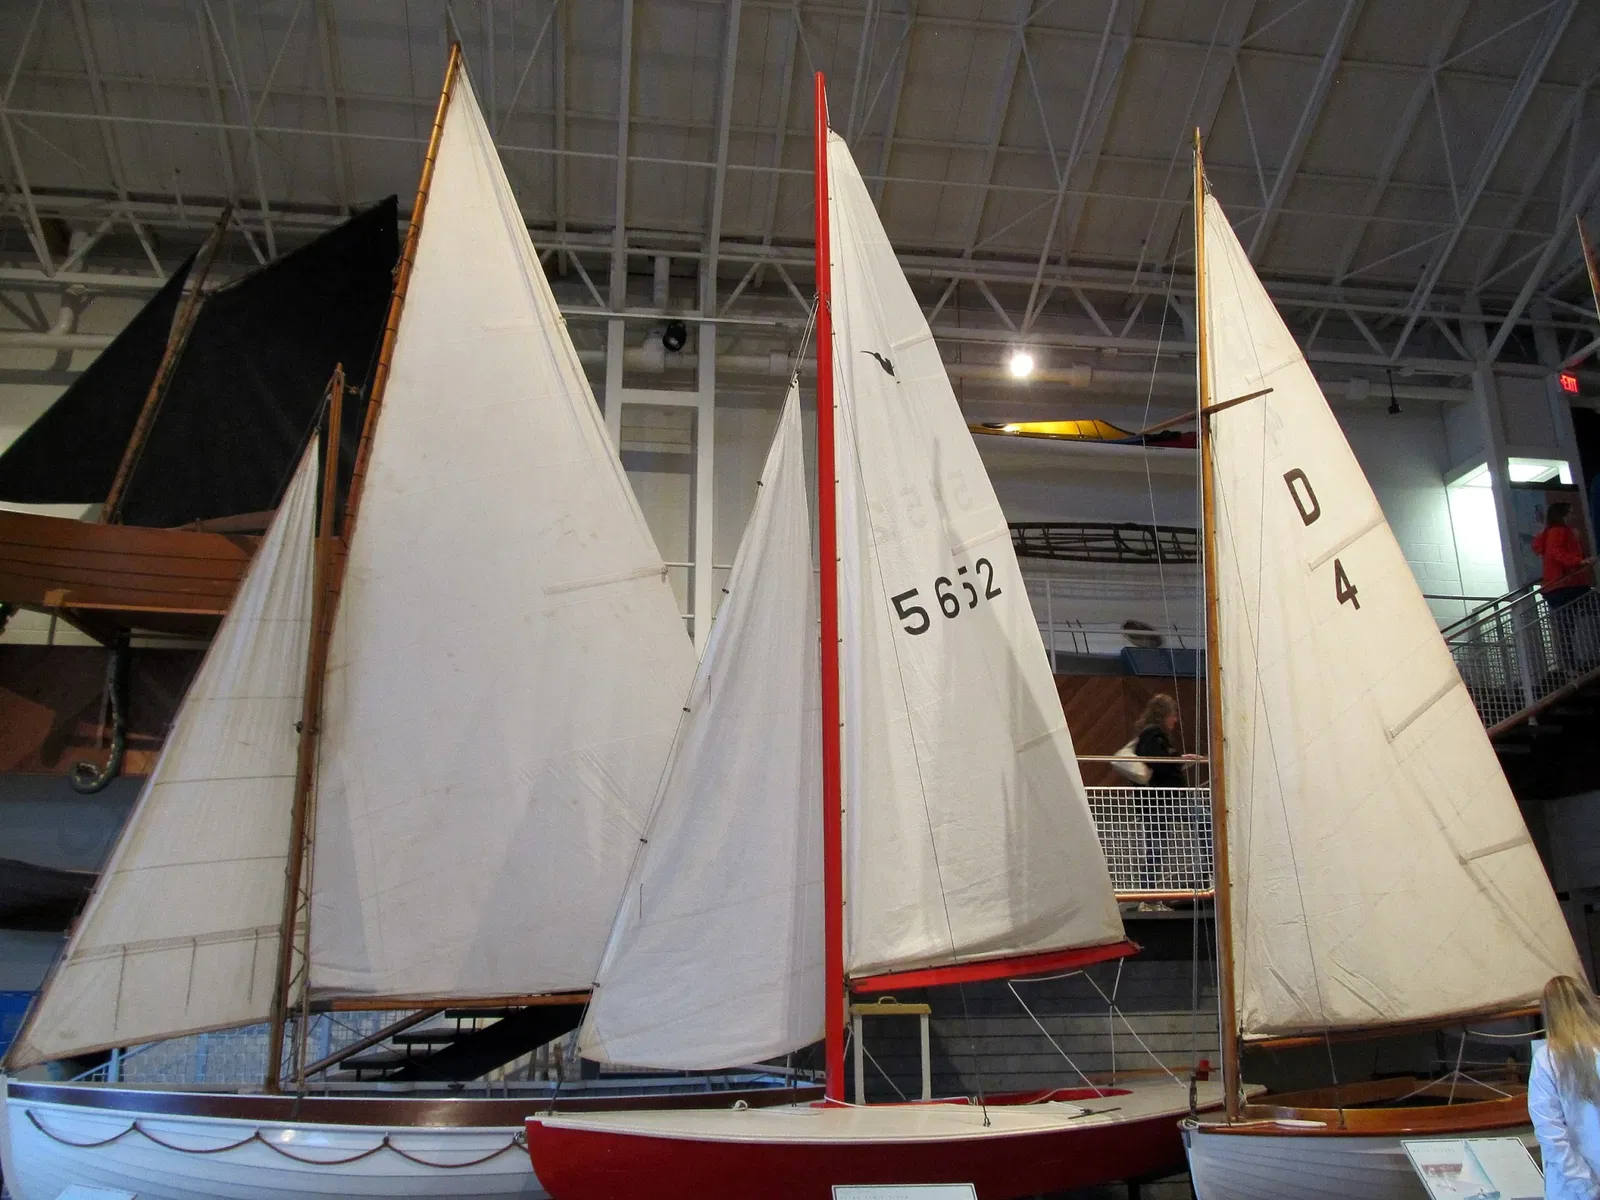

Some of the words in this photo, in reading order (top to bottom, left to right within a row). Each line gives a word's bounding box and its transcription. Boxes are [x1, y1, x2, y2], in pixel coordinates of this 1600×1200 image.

[1283, 468, 1321, 526] D
[891, 557, 1002, 635] 5652
[1334, 558, 1360, 610] 4
